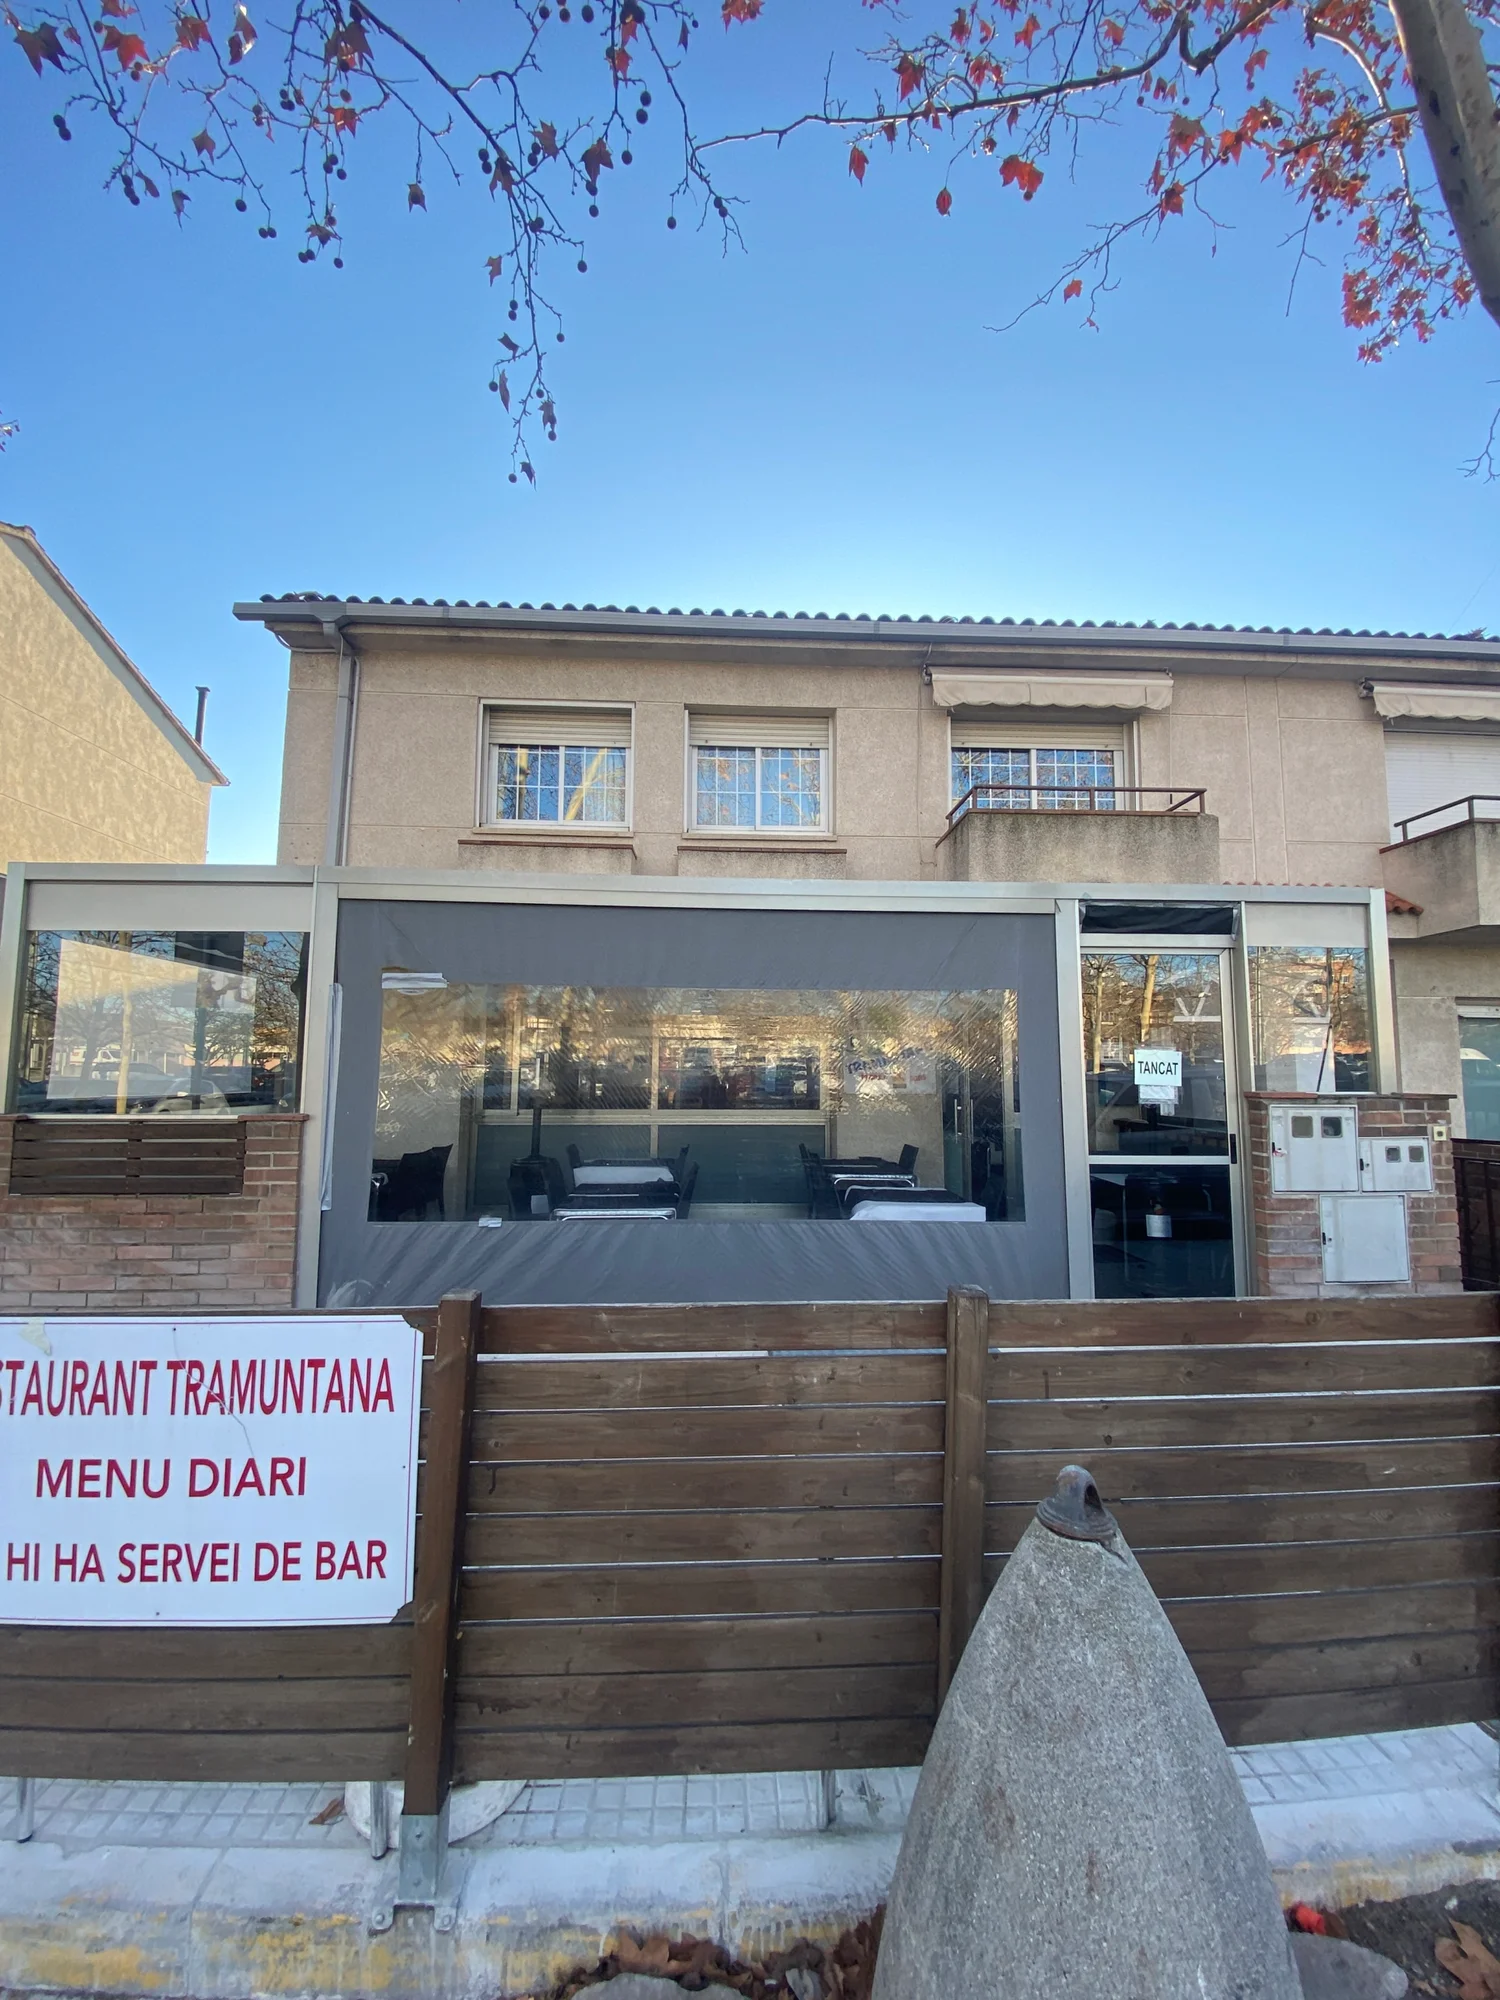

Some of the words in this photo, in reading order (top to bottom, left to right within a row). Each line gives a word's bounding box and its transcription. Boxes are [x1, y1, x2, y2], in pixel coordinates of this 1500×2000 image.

[1137, 1060, 1179, 1076] TANCAT
[0, 1359, 158, 1417] TAURANT
[166, 1357, 395, 1416] TRAMUNTANA
[35, 1458, 171, 1498] MENU
[188, 1456, 307, 1498] DIARI
[7, 1542, 41, 1582] HI
[54, 1543, 105, 1583] HA
[117, 1542, 240, 1583] SERVEI
[253, 1541, 303, 1582] DE
[315, 1539, 388, 1581] BAR
